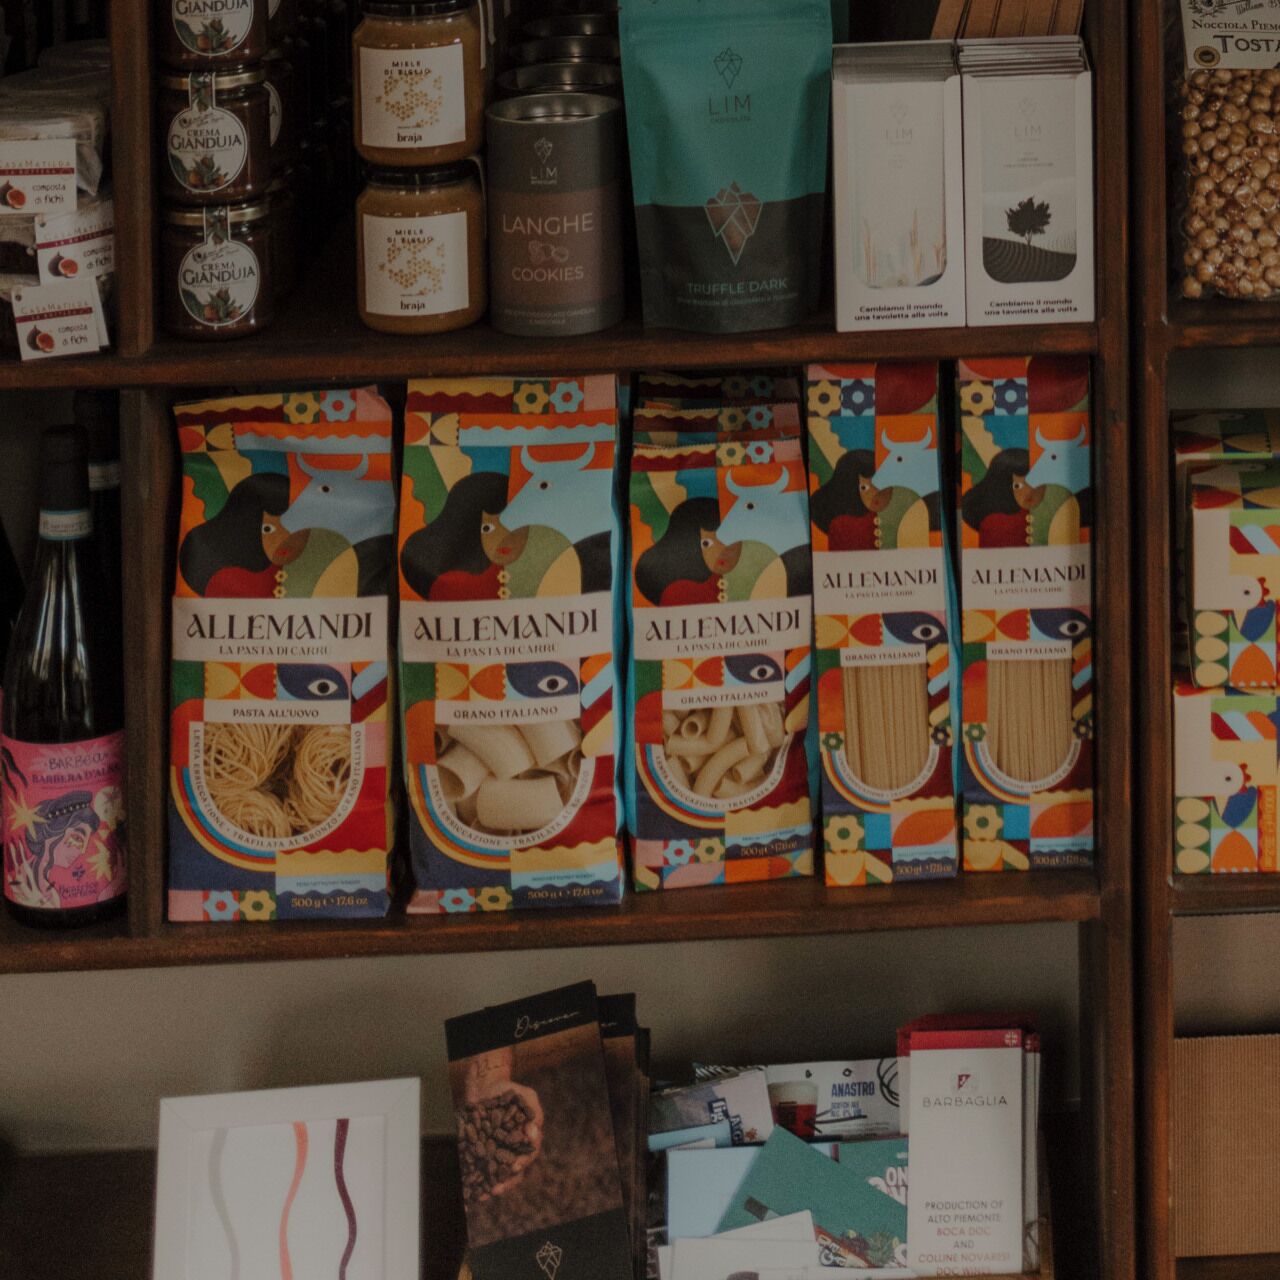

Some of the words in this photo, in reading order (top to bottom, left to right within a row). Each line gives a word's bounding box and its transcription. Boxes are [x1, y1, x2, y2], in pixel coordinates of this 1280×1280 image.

[1191, 18, 1249, 33] NOCCIOLA
[708, 95, 752, 116] LIM
[502, 212, 595, 236] LANGHE
[511, 266, 585, 283] COOKIES
[686, 281, 748, 295] TRUFFLE
[749, 278, 788, 292] DARK
[401, 301, 427, 312] braja
[823, 567, 938, 590] ALLEMANDI
[972, 563, 1087, 586] ALLEMANDI
[187, 611, 373, 641] ALLEMANDI
[414, 609, 599, 641] ALLEMANDI
[645, 609, 801, 642] ALLEMANDI
[233, 707, 265, 719] PASTA
[267, 708, 320, 718] ALL'UOVO
[453, 708, 498, 720] GRANO
[501, 704, 560, 719] ITALIANO
[831, 1081, 876, 1098] ANASTRO
[922, 1096, 1009, 1108] BARBAGLIA
[924, 1200, 987, 1211] PRODUCTION
[990, 1200, 1004, 1210] OF
[927, 1213, 950, 1224] ALTO
[952, 1213, 1002, 1223] PIEMONTE
